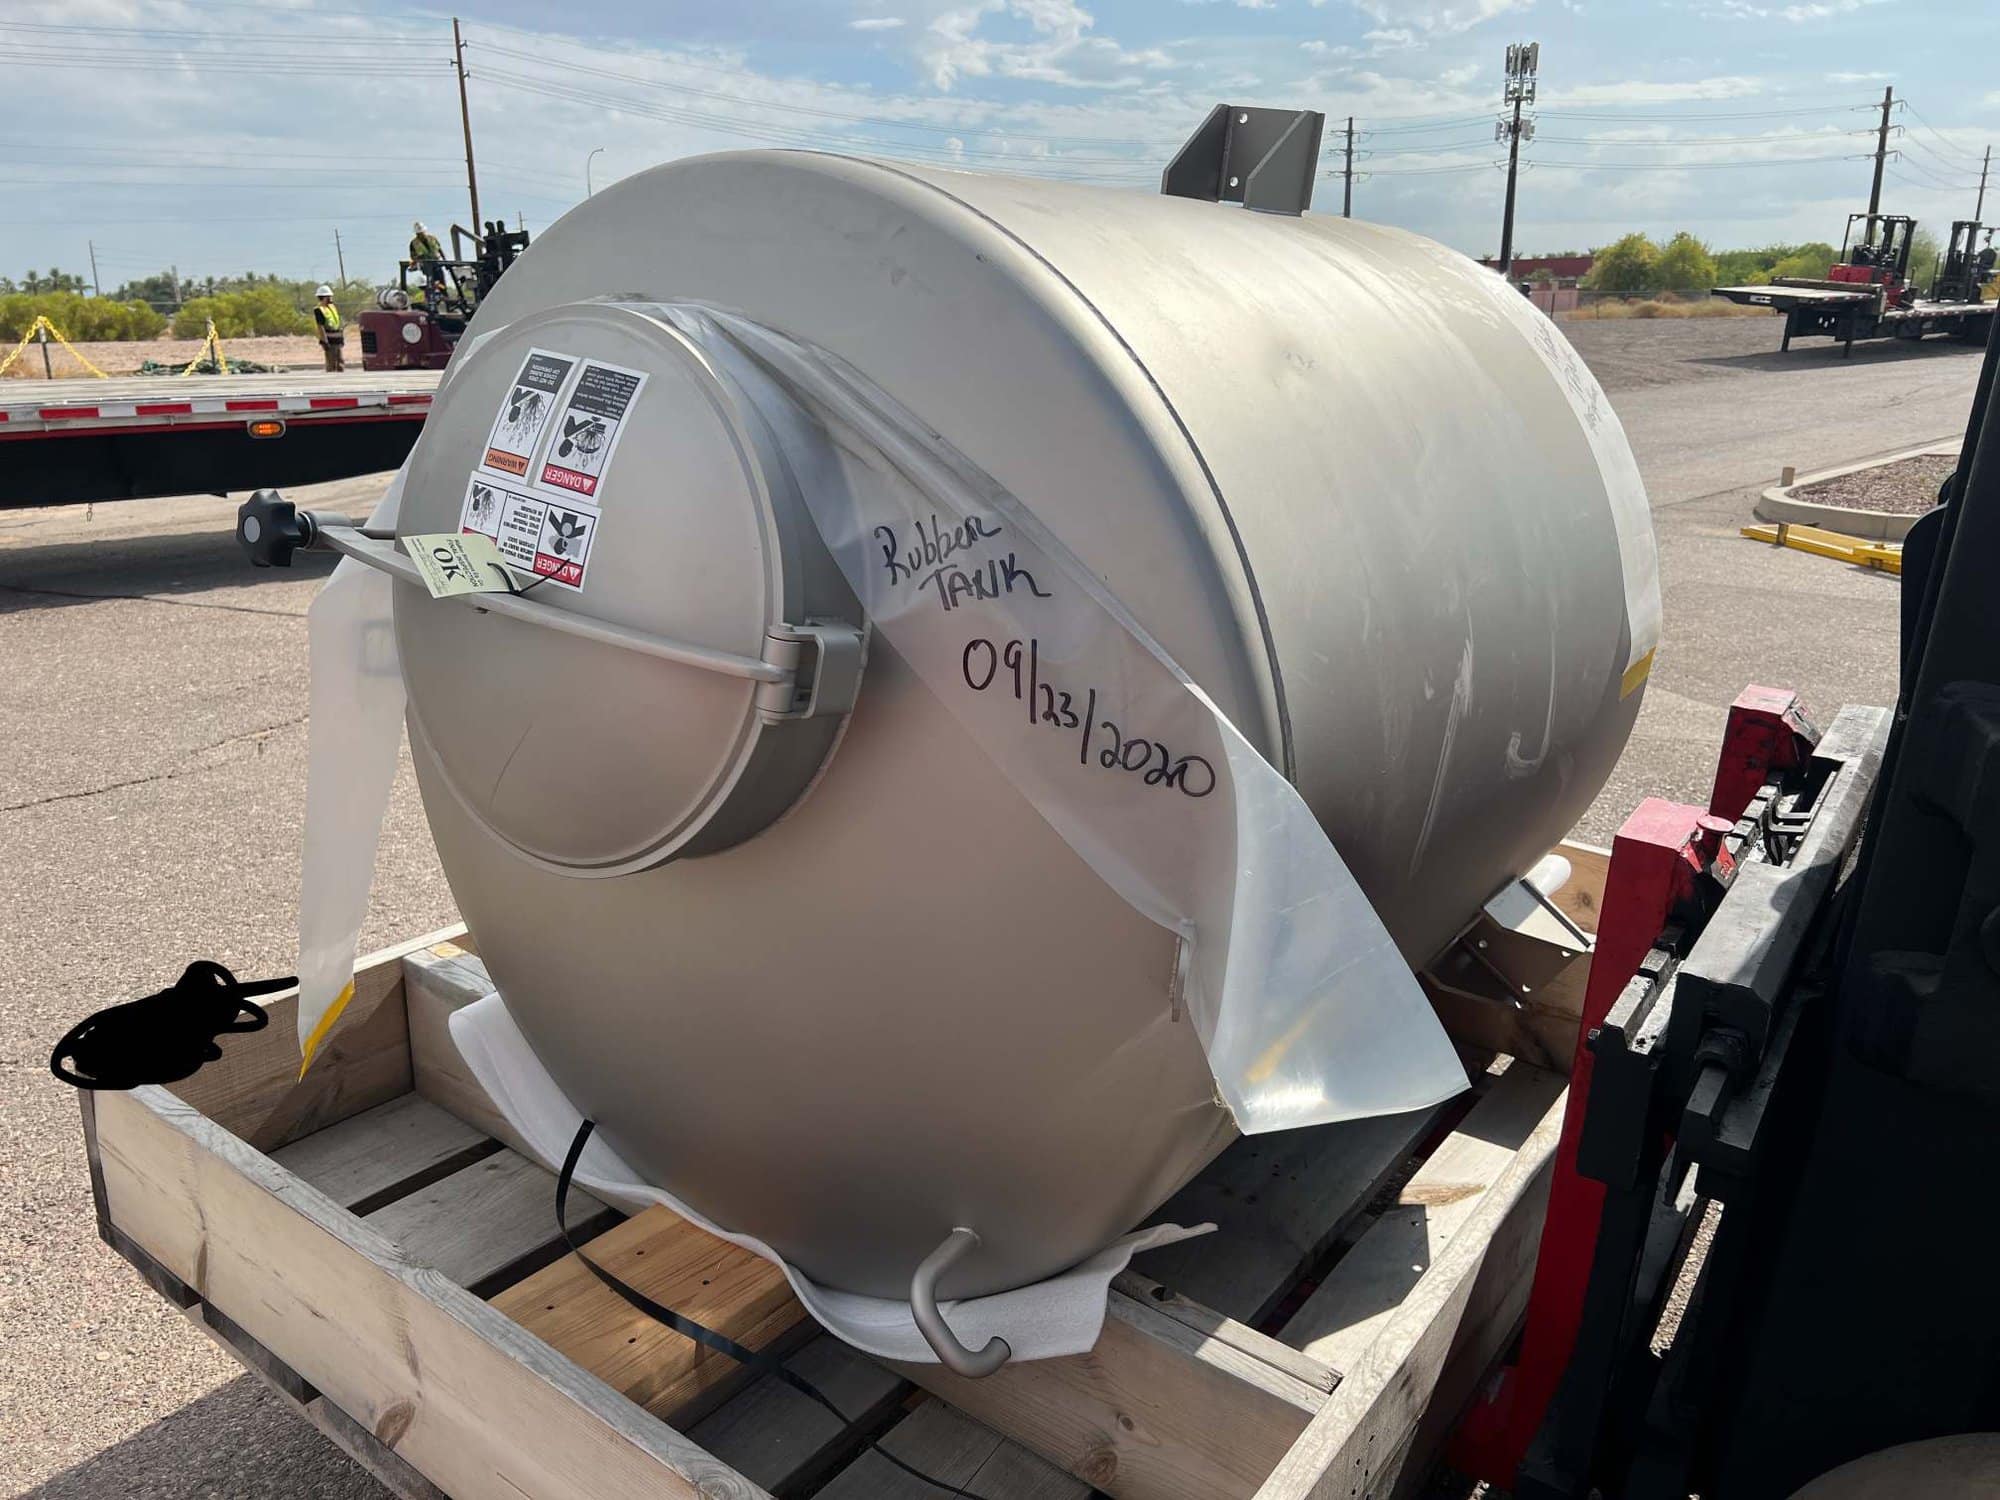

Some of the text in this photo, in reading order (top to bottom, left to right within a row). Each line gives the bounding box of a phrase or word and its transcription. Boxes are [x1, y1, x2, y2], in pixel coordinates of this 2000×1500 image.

[488, 453, 518, 468] WARNING
[545, 468, 582, 487] DANGER
[433, 547, 466, 580] OK
[919, 553, 1052, 611] TANK
[963, 639, 1216, 798] 09/23/2020
